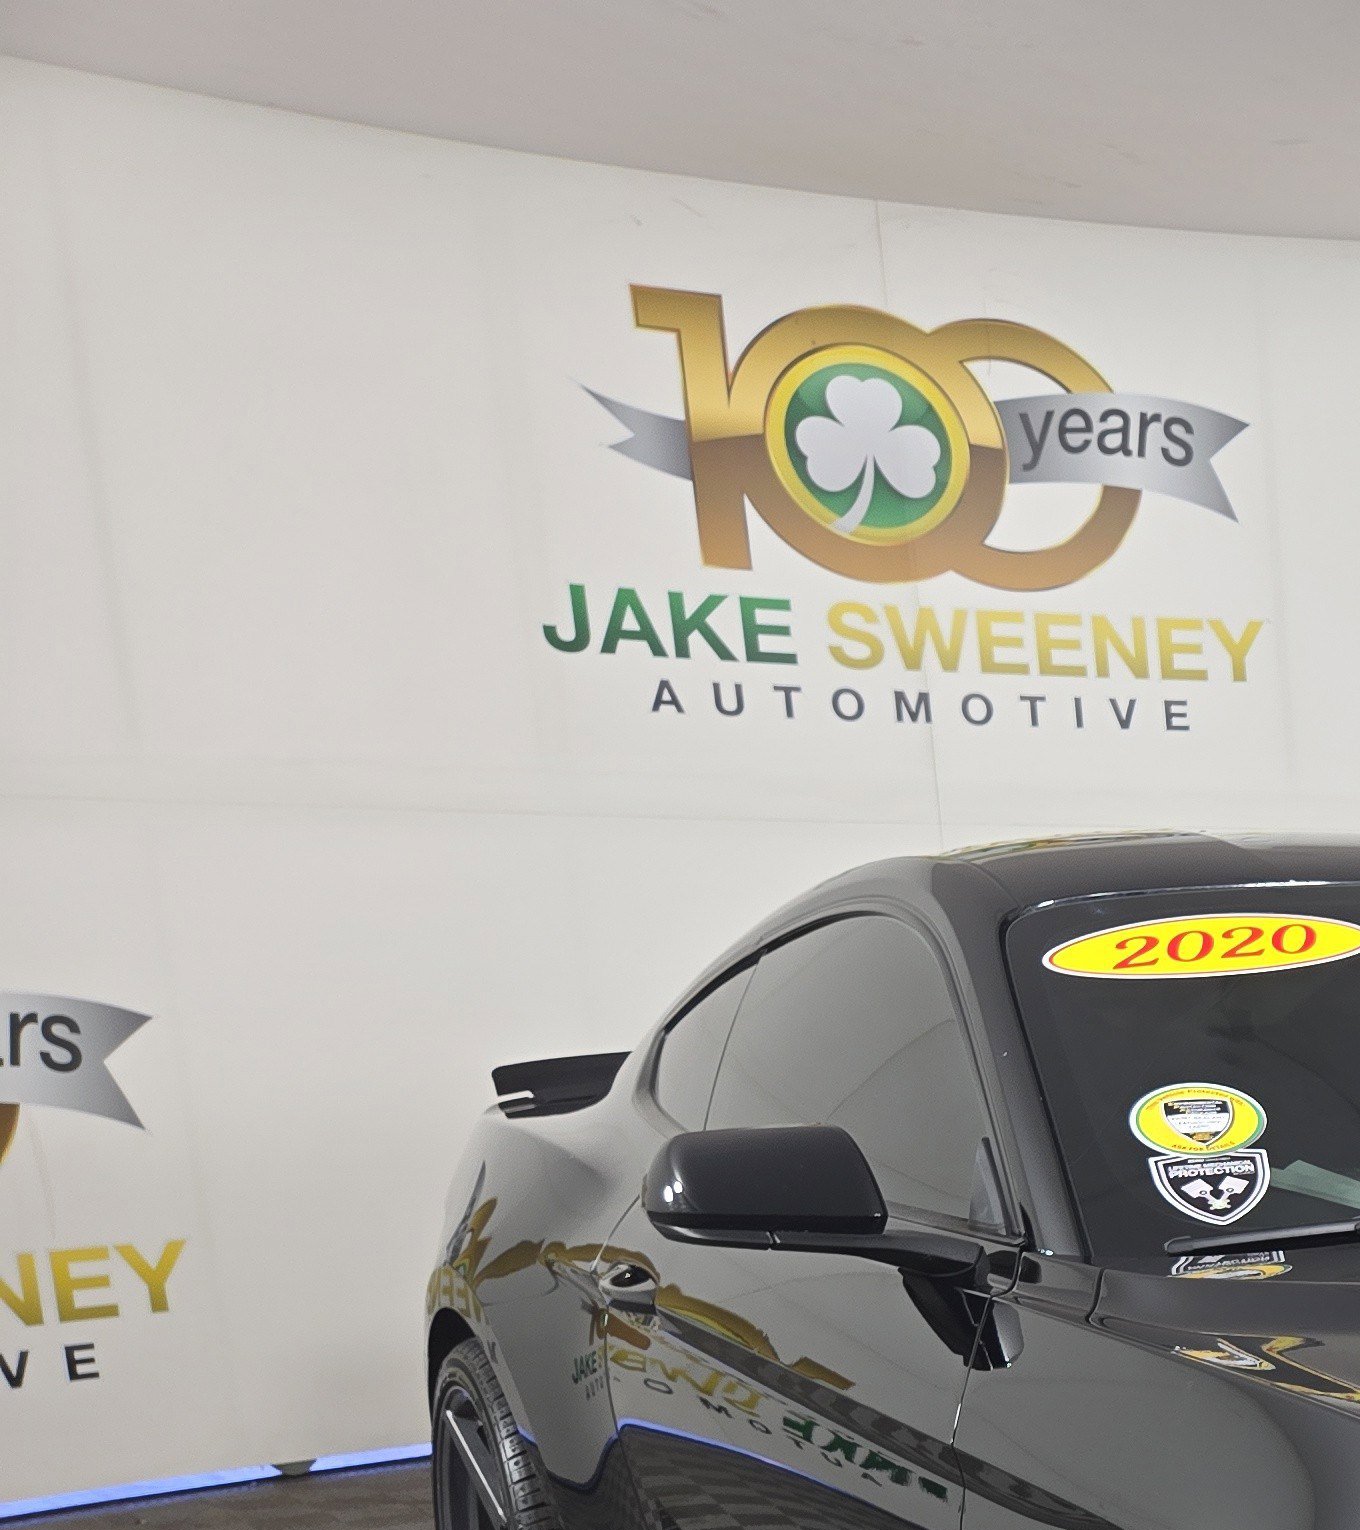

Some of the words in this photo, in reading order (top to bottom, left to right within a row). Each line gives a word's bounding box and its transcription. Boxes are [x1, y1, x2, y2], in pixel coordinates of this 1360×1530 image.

[629, 283, 1143, 592] 100
[1018, 405, 1196, 472] years
[542, 582, 799, 665] JAKE
[826, 600, 1265, 683] SWEENEY
[650, 678, 1192, 732] AUTOMOTIVE
[1112, 923, 1318, 970] 2020
[0, 1012, 83, 1073] rs
[1169, 1163, 1256, 1179] PROTECTION
